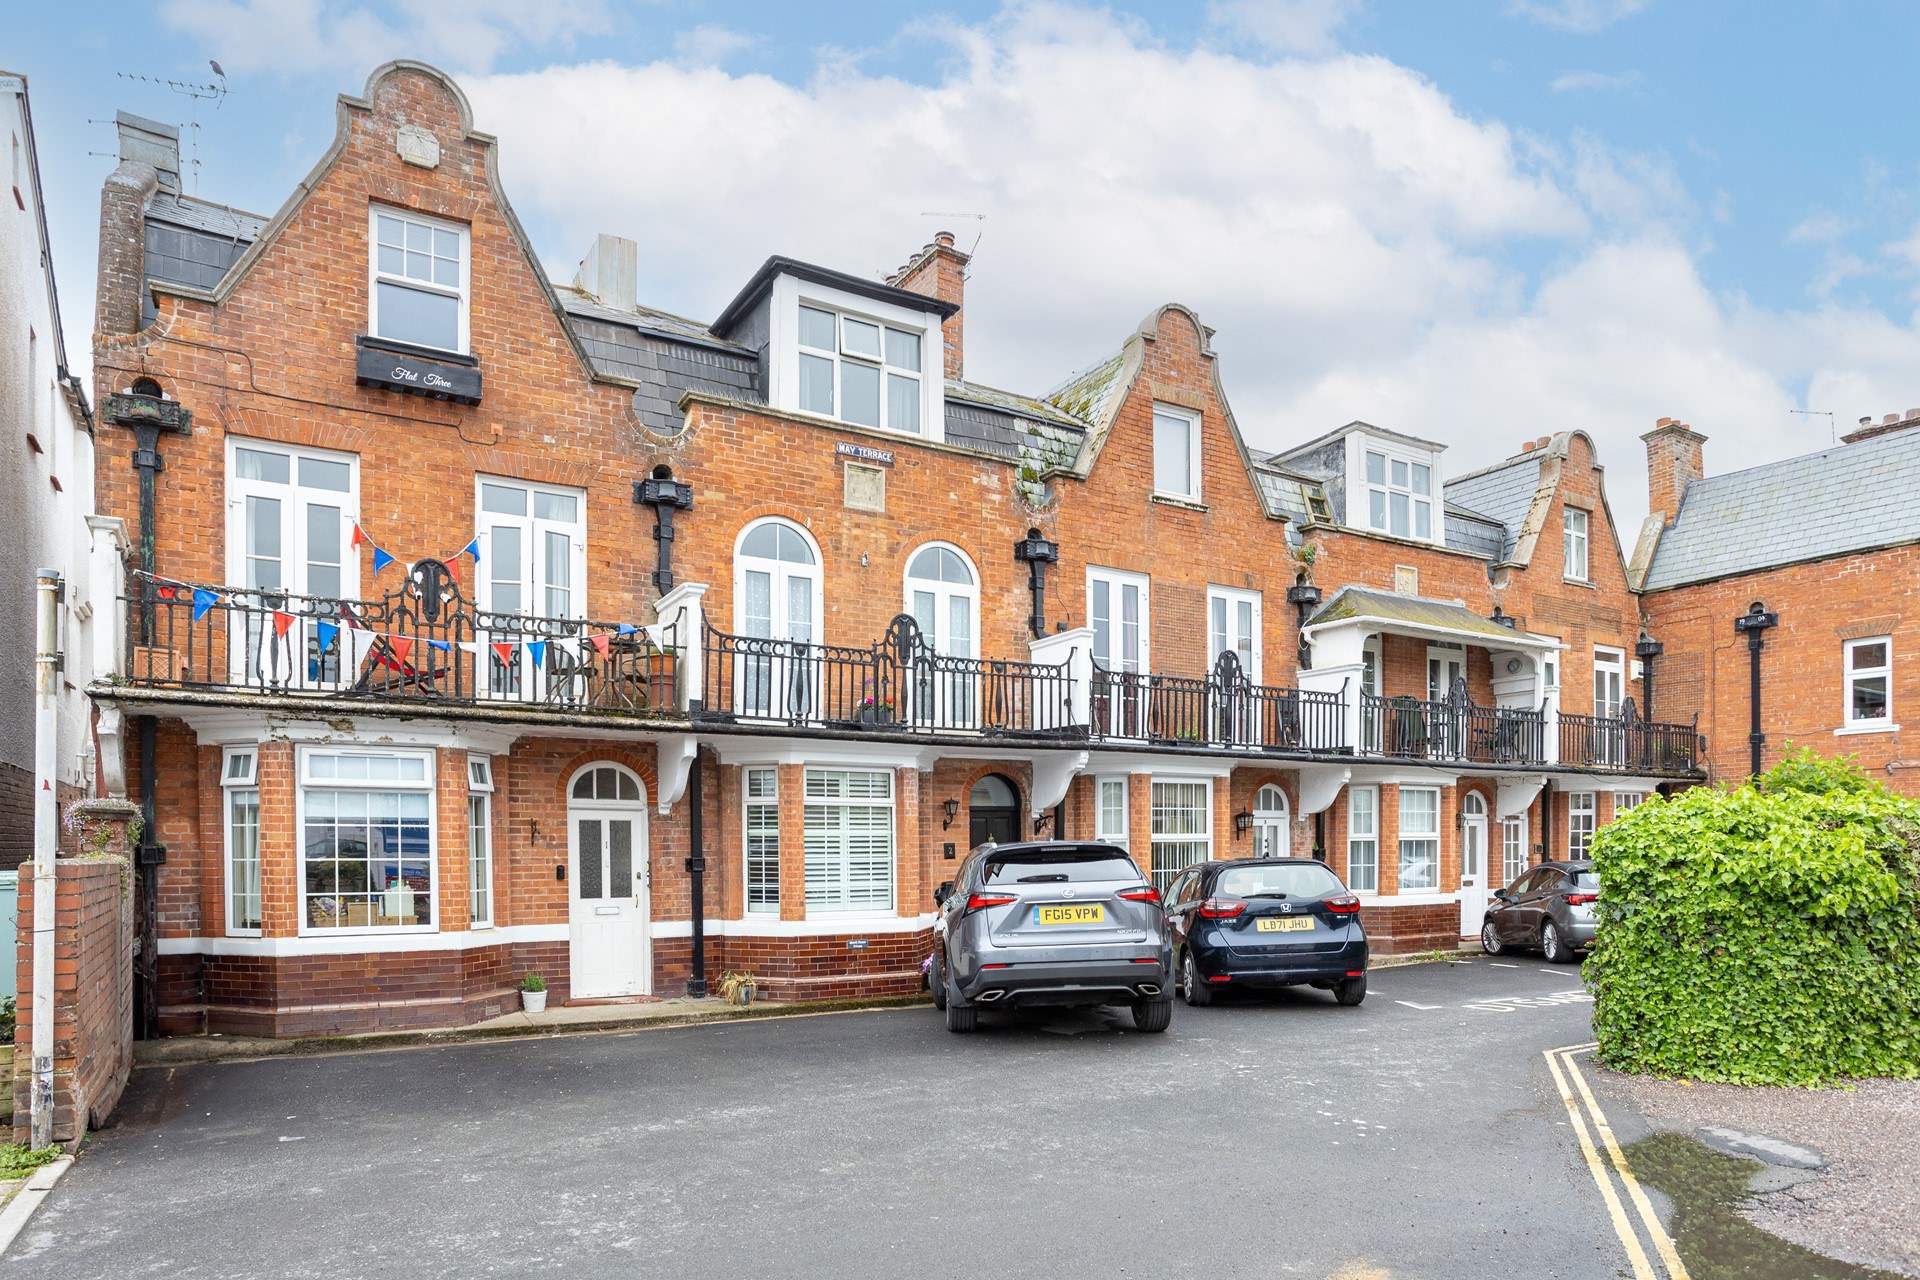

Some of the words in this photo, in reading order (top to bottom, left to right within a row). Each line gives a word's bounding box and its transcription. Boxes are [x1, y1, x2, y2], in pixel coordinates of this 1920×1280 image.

[391, 367, 418, 381] Flat
[423, 373, 452, 388] Three
[838, 443, 855, 455] MAY
[858, 447, 892, 462] TERRACE
[948, 846, 953, 855] 2
[1045, 908, 1072, 920] FG15
[1075, 907, 1099, 919] VPW
[1288, 919, 1308, 929] JHU
